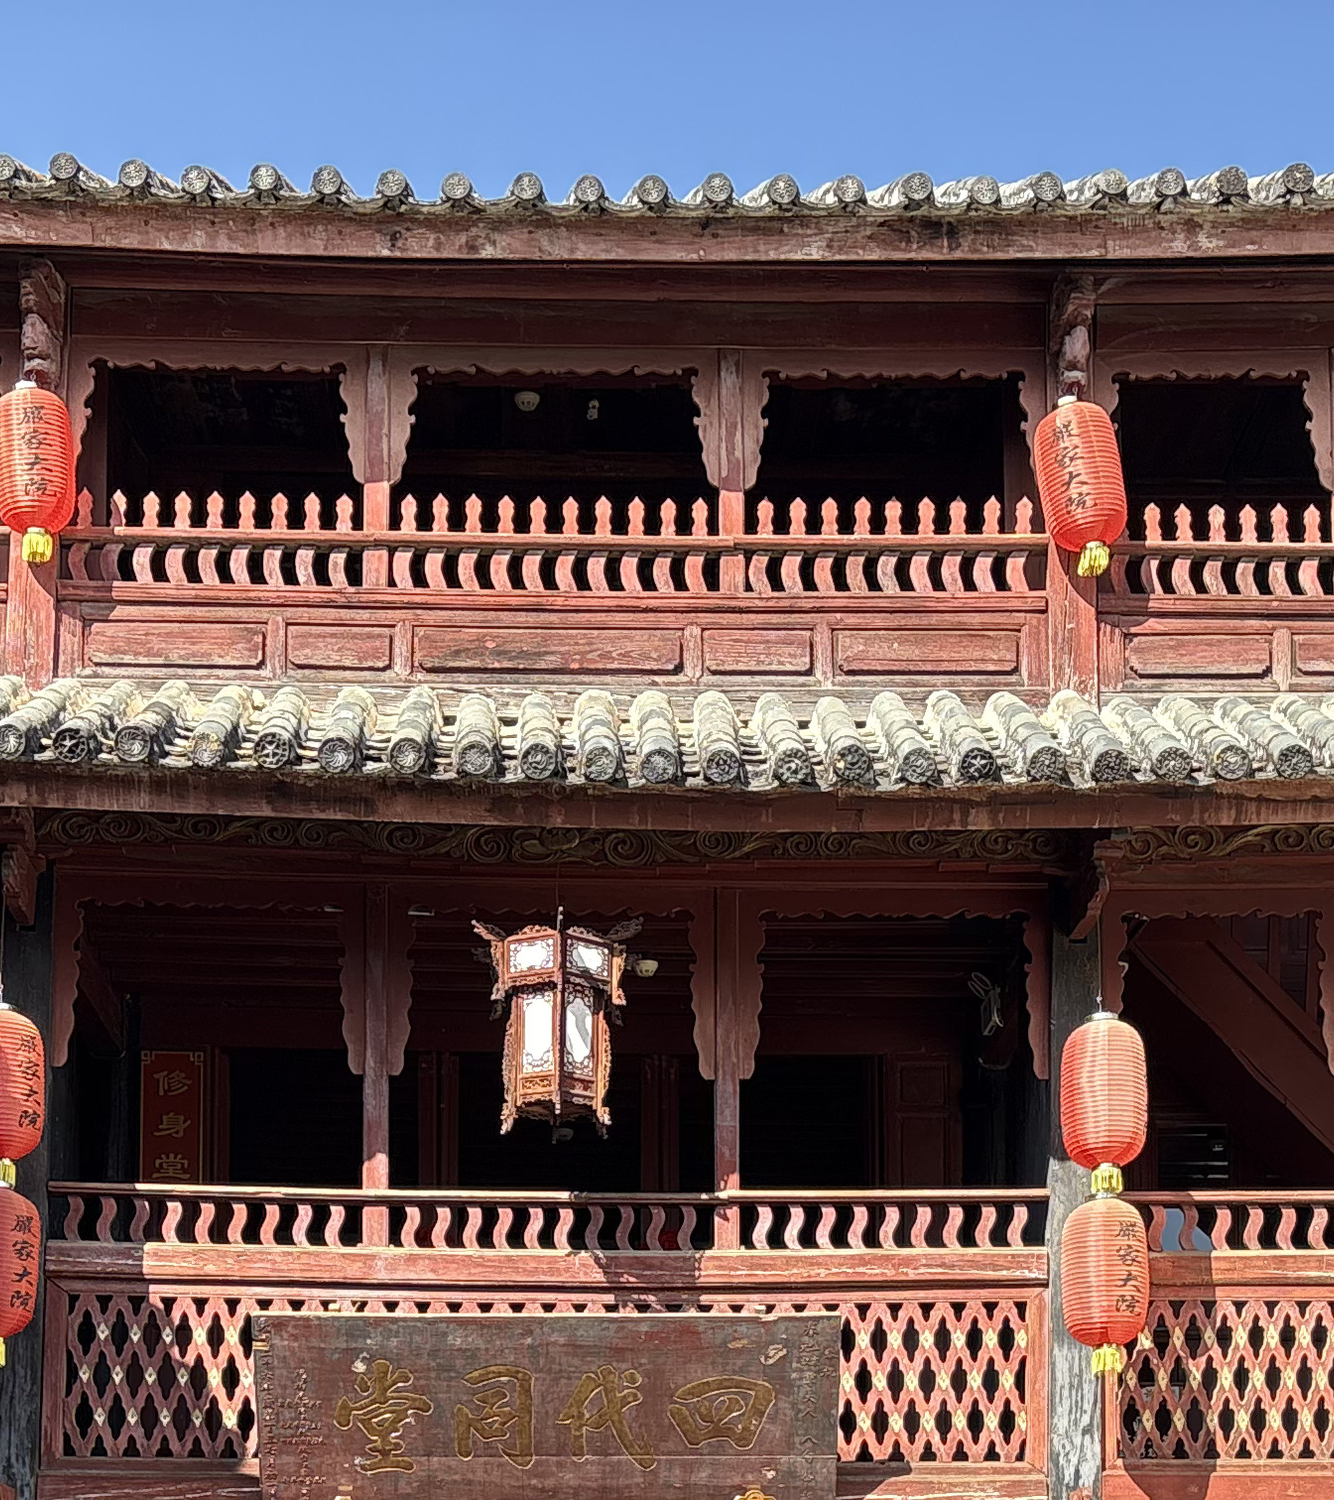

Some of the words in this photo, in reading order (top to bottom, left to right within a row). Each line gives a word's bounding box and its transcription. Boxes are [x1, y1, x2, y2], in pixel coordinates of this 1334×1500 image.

[152, 1070, 193, 1180] 修身堂
[332, 1359, 777, 1474] 四代同堂
